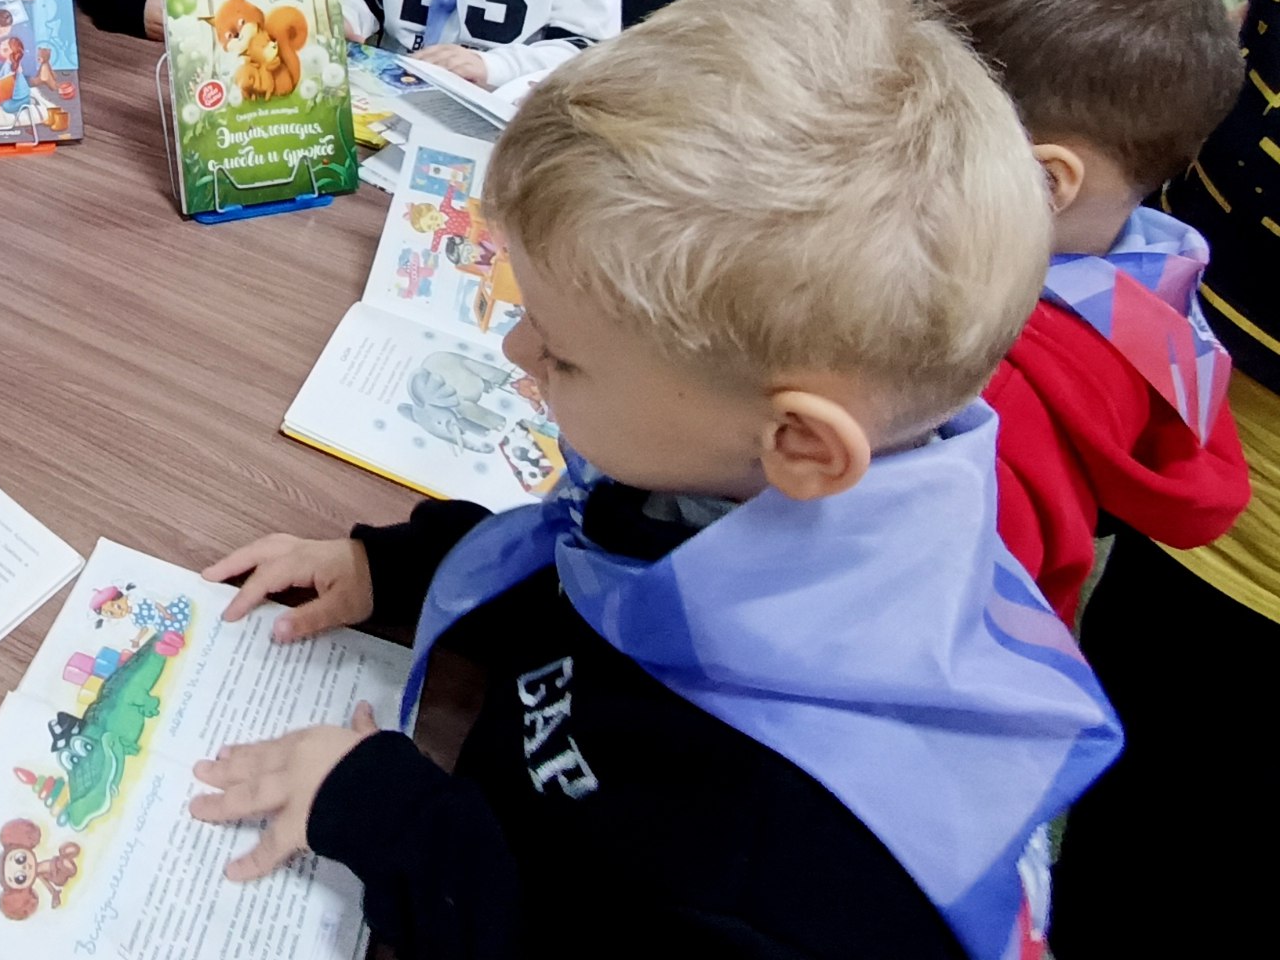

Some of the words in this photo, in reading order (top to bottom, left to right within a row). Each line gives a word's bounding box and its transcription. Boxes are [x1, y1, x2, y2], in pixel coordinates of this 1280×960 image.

[216, 123, 323, 148] Энциклопедия
[223, 146, 265, 169] любви
[268, 151, 279, 162] и
[283, 134, 335, 167] дружбе
